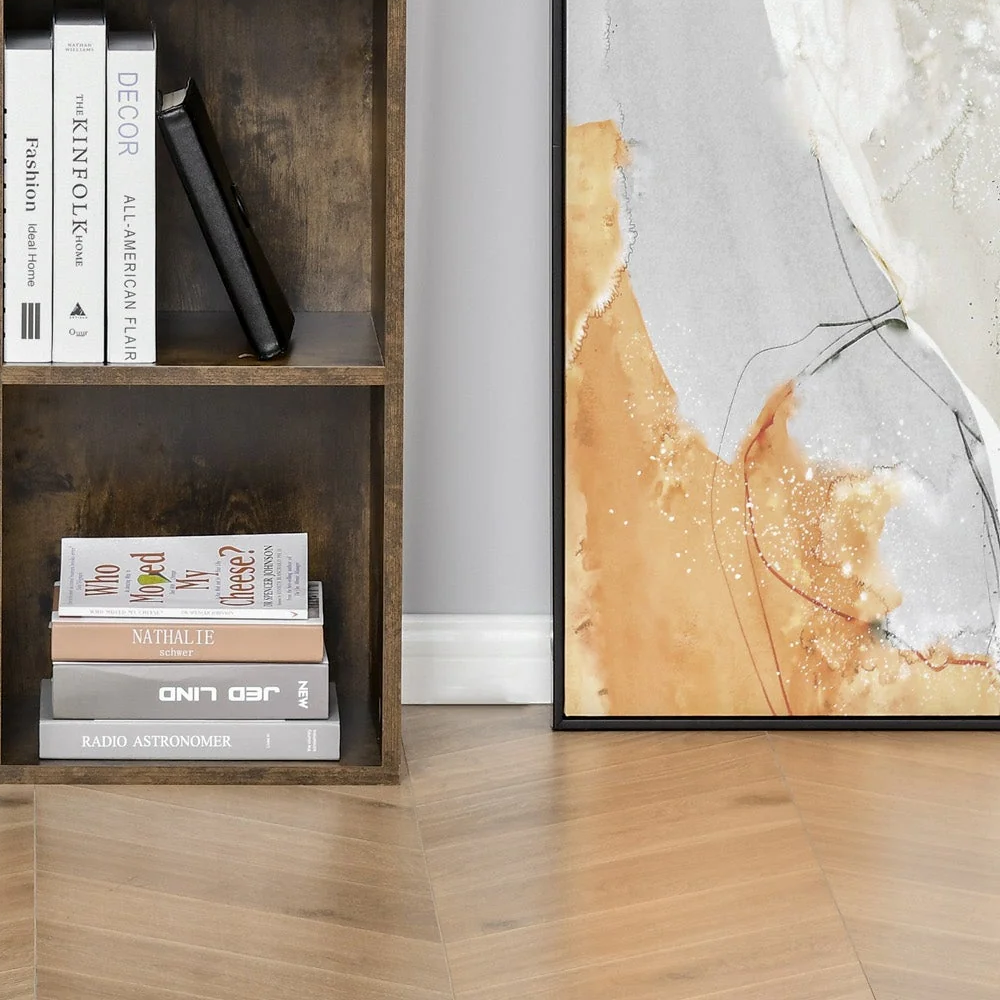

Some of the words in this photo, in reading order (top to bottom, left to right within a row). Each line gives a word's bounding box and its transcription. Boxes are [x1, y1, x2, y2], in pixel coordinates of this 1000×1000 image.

[75, 94, 84, 116] THE
[117, 72, 139, 156] DECOR
[25, 137, 40, 212] Fashion
[71, 117, 88, 235] KINFOLK
[27, 223, 38, 250] Ideal
[75, 235, 84, 267] HOME
[123, 194, 137, 310] ALL-AMERICAN
[27, 252, 37, 288] Home
[123, 317, 137, 361] FLAIR
[84, 564, 121, 597] Who
[175, 569, 219, 592] My
[218, 545, 256, 607] Cheese?
[263, 545, 276, 577] JOHNSON
[132, 629, 215, 645] NATHALIE
[159, 648, 194, 657] schwer
[158, 686, 217, 702] LIND
[228, 686, 281, 702] JED
[297, 680, 309, 709] NEW
[81, 735, 128, 748] RADIO
[132, 735, 232, 749] ASTRONOMER
